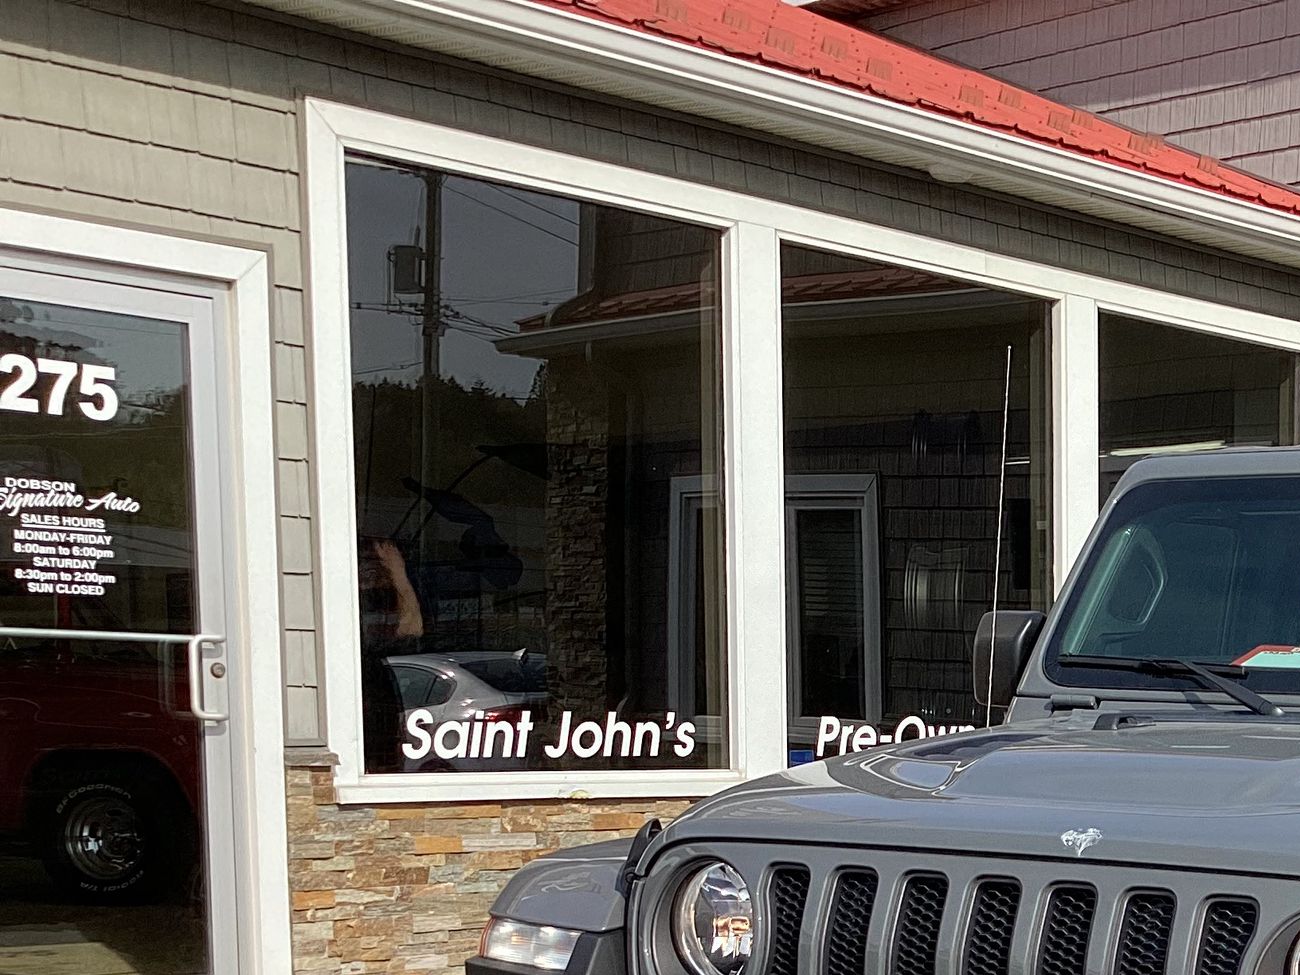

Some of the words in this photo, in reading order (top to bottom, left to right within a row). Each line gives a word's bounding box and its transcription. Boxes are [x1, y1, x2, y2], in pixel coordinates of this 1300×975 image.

[0, 353, 119, 421] 275
[5, 477, 76, 492] DOBSON
[0, 486, 84, 516] Signature
[85, 492, 140, 512] Auto
[20, 513, 60, 525] SALES
[62, 516, 105, 528] HOURS
[13, 529, 112, 545] MONDAY-FRIDAY
[13, 542, 56, 555] 8:00am
[58, 546, 70, 556] to
[72, 546, 115, 559] 6:00pm
[33, 556, 97, 569] SATURDAY
[60, 571, 72, 582] to
[74, 571, 116, 585] 2:00pm
[27, 582, 54, 593] SUN
[55, 583, 105, 595] CLOSED
[402, 709, 535, 761] Saint
[544, 709, 697, 760] John's
[816, 715, 977, 756] Pre-O
